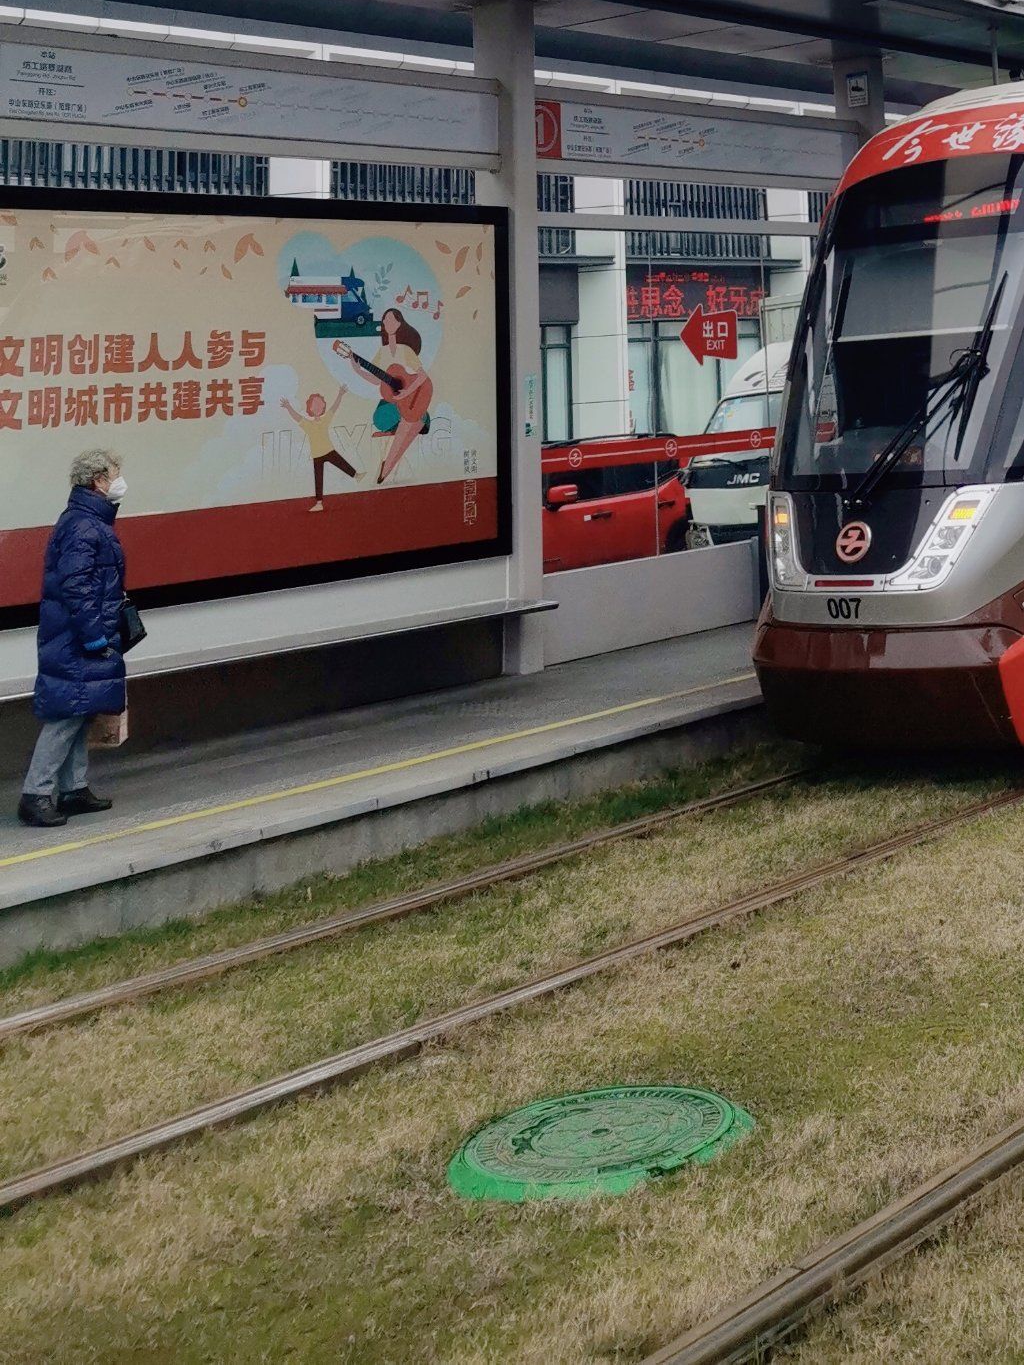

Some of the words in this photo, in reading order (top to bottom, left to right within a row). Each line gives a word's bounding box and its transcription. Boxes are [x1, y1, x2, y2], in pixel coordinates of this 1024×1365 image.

[702, 320, 729, 338] 出口
[0, 330, 266, 377] 文明创建人人参与
[706, 339, 725, 351] EXIT
[0, 377, 265, 430] 文明城市共建共享
[727, 472, 760, 485] JMC
[827, 597, 862, 619] 007
